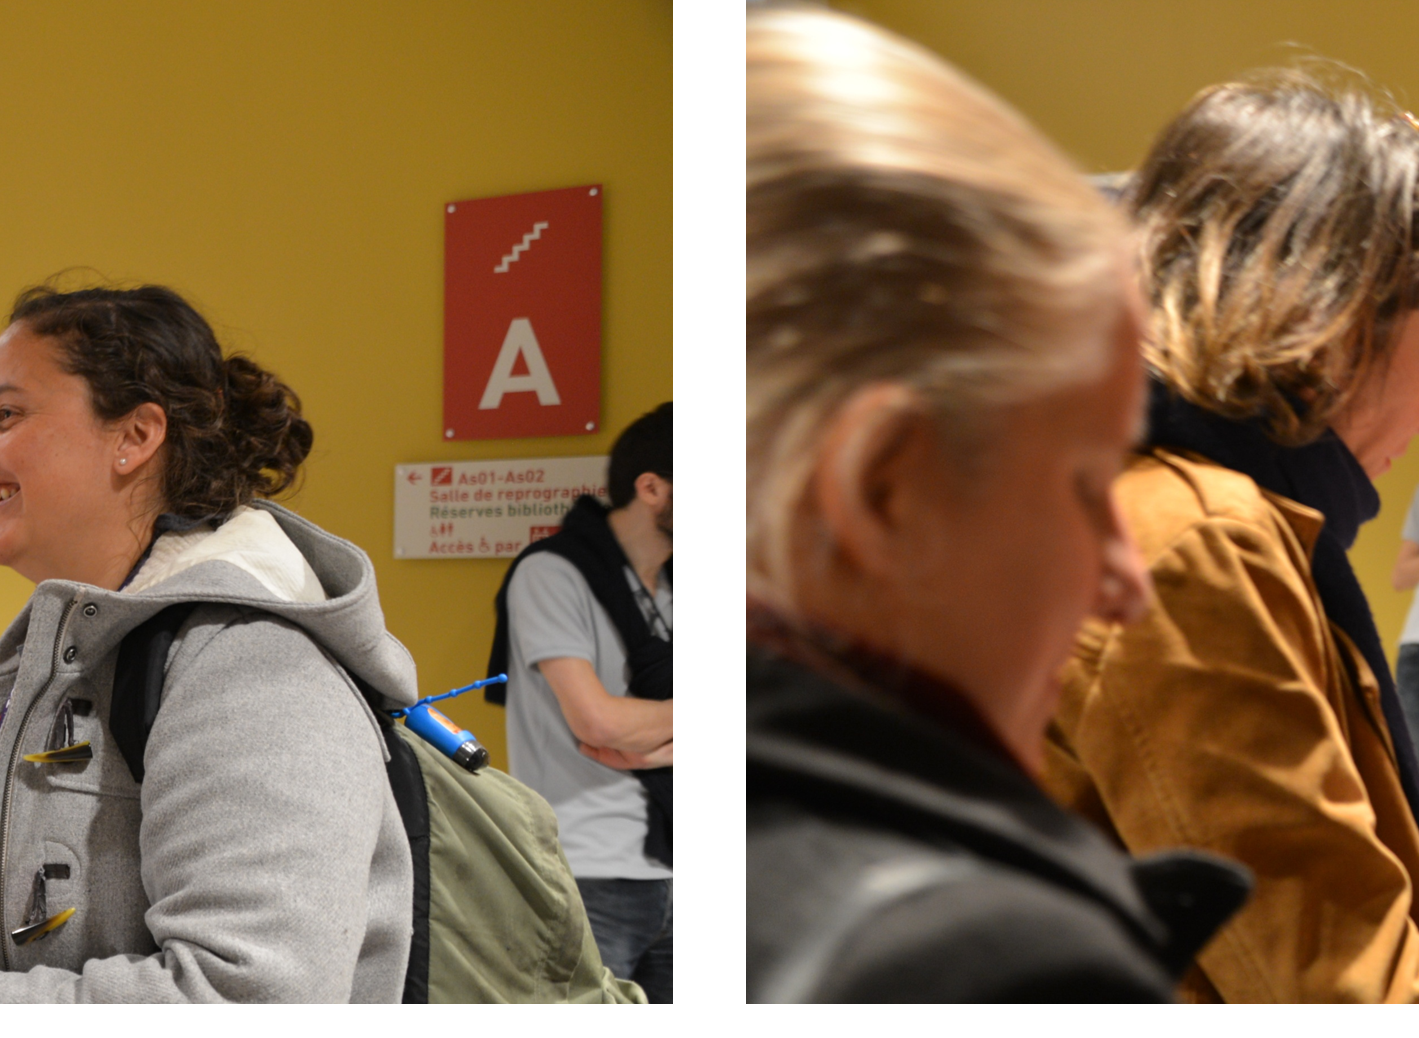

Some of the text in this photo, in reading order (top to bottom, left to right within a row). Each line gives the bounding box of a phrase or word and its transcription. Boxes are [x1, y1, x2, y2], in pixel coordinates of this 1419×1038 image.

[478, 317, 561, 410] A
[459, 469, 545, 485] As01-As02
[430, 484, 607, 503] Salle de reprographie
[430, 501, 571, 520] Réserves biblioth
[430, 541, 521, 556] Accès par
